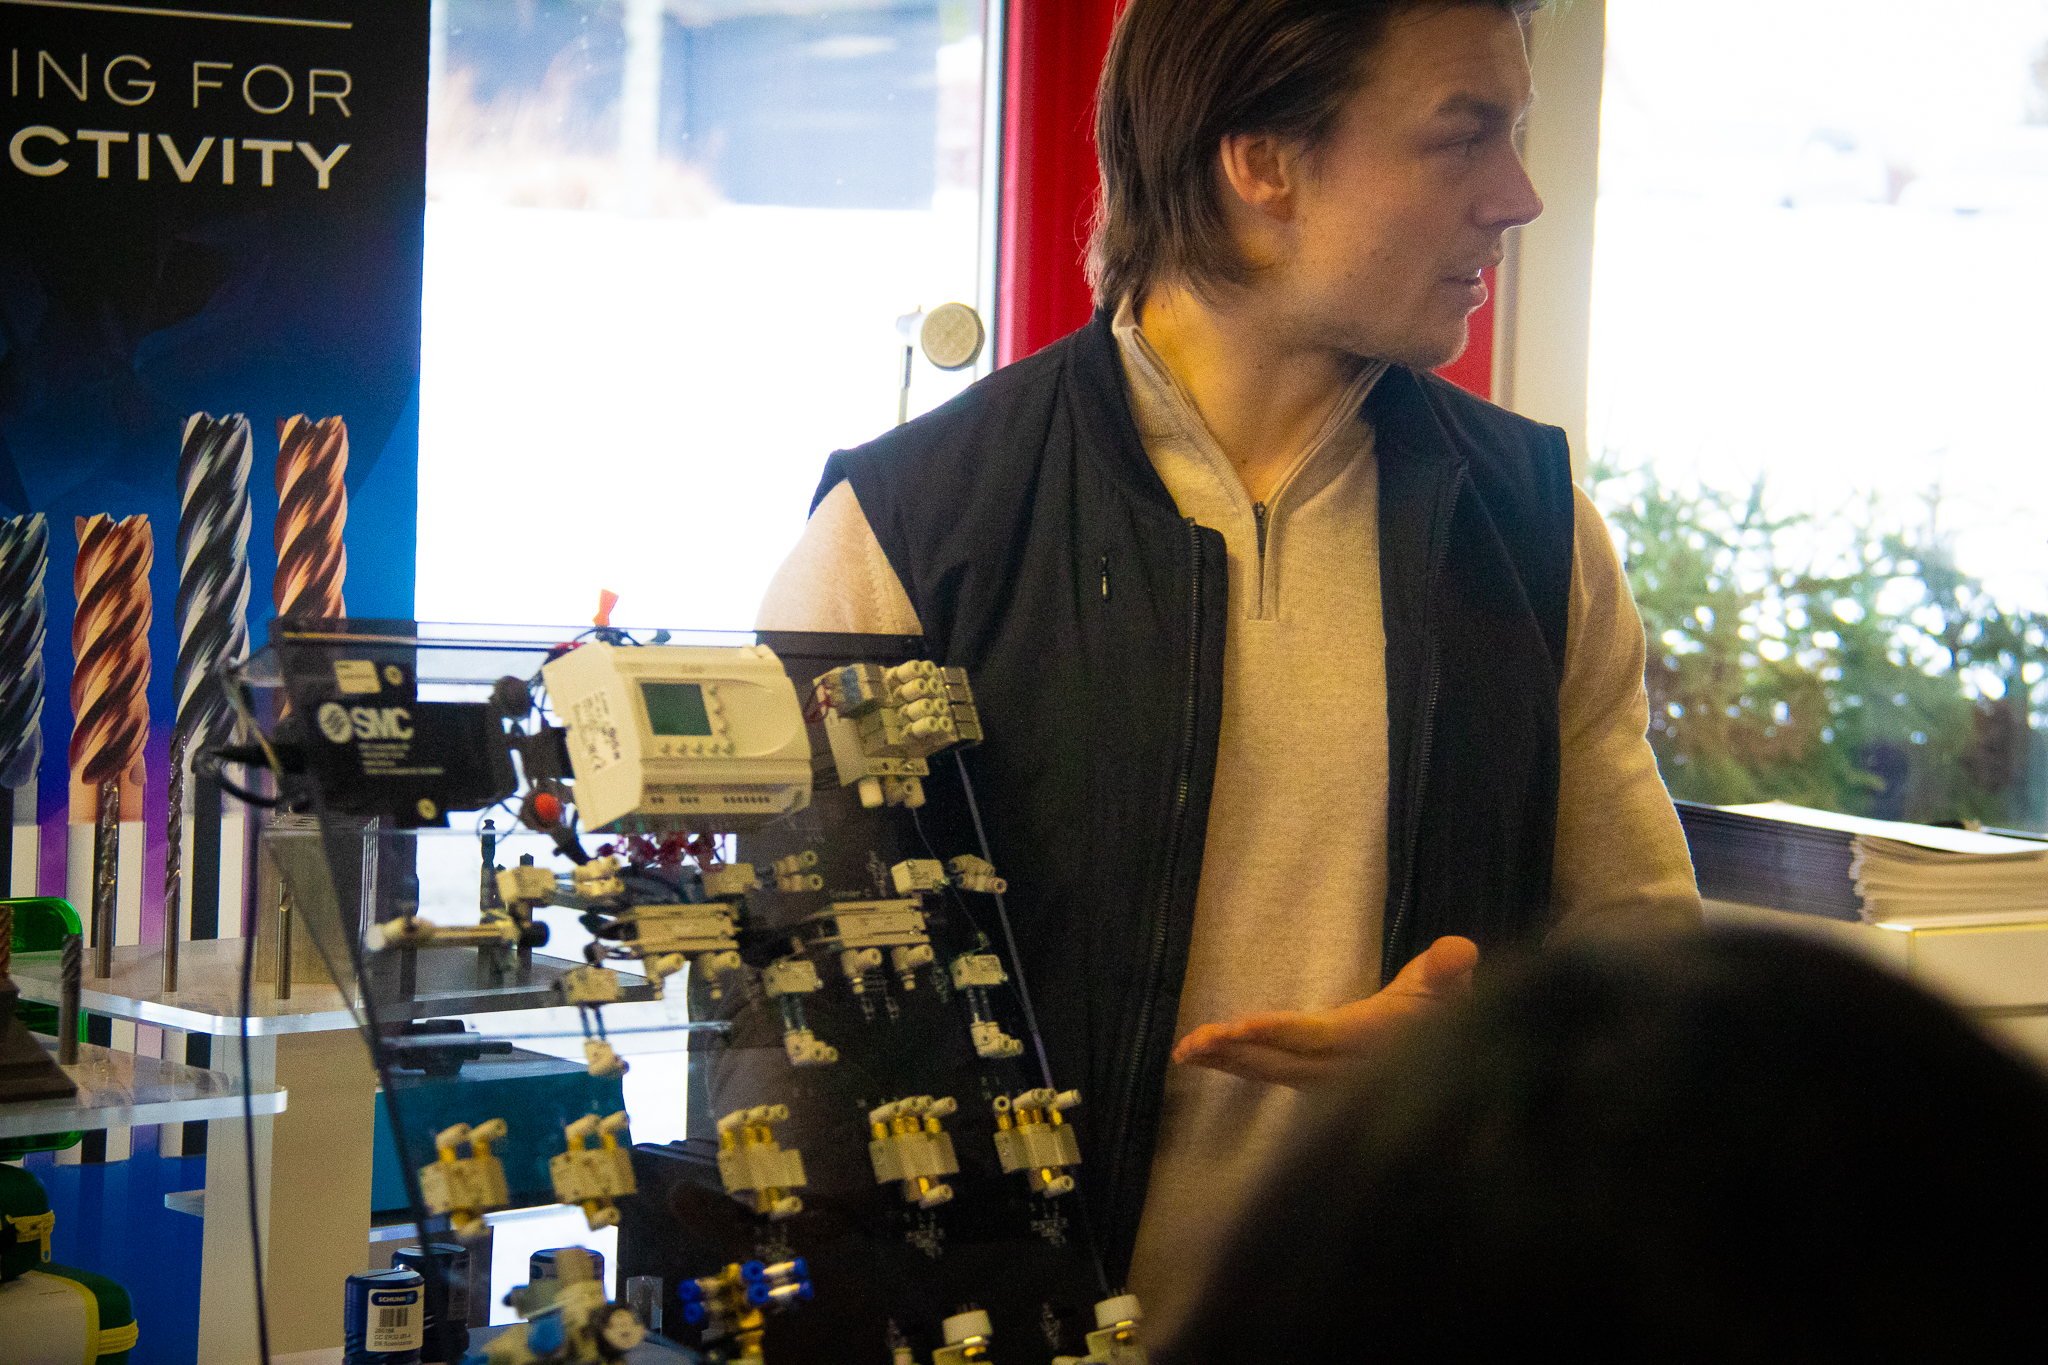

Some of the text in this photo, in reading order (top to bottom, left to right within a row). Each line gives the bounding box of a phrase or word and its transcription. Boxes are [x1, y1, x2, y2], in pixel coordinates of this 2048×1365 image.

[12, 48, 352, 118] ING FOR
[9, 125, 352, 190] CTIVITY
[351, 706, 413, 739] SMC
